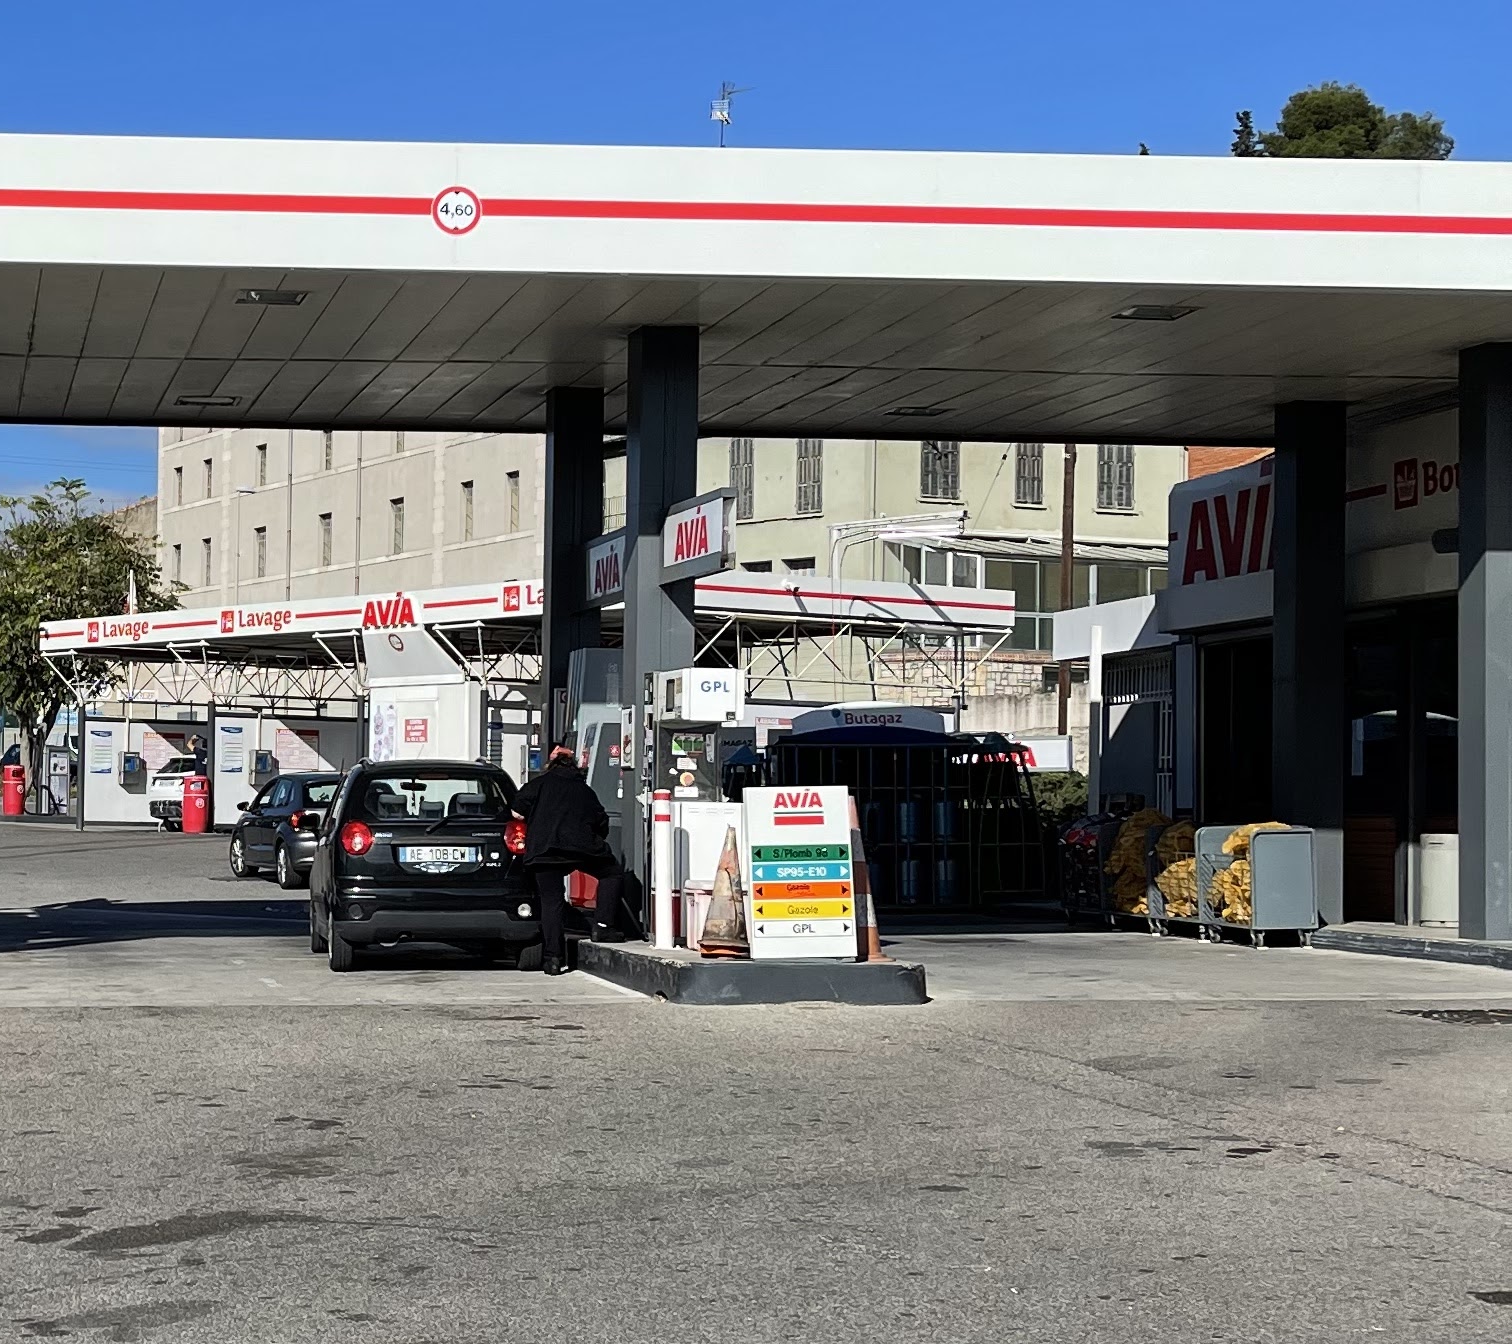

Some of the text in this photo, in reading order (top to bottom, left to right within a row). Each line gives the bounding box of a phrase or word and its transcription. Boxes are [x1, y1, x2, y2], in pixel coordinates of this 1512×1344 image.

[440, 203, 473, 218] 4,60
[1182, 457, 1275, 586] AVI
[238, 610, 292, 632] Lavage
[102, 621, 149, 641] Lavage
[700, 681, 730, 693] GPL
[844, 712, 903, 727] Butagaz
[772, 848, 812, 859] S/Plomb
[777, 867, 827, 877] SP95-E10
[787, 905, 819, 915] Gazole
[792, 924, 816, 934] GPL
